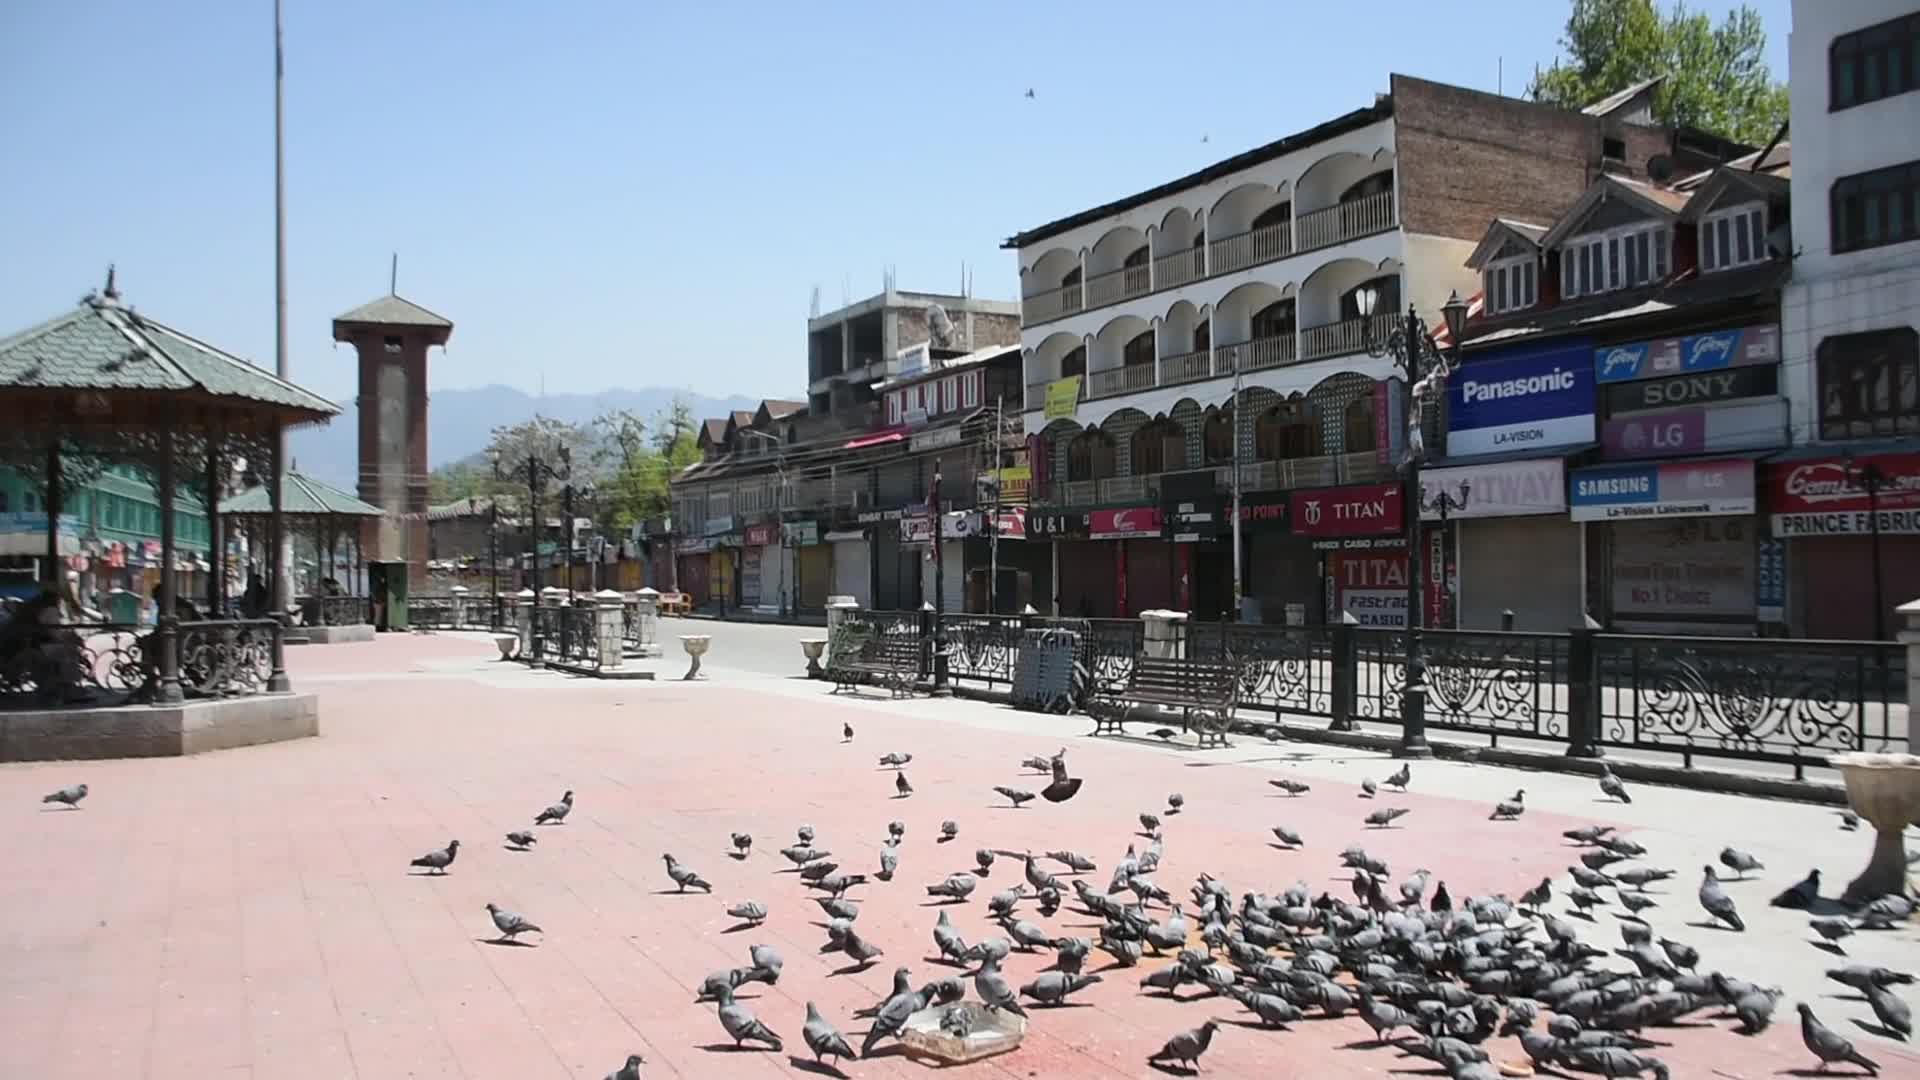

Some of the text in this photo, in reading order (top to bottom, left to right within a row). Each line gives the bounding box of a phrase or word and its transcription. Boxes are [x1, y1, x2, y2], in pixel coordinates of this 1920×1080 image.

[1463, 367, 1574, 403] Panasonic
[1643, 374, 1737, 405] SONY
[1493, 429, 1544, 445] LA-VISION
[1653, 422, 1685, 447] LG
[1578, 476, 1650, 497] SAMSUNG
[1253, 504, 1286, 521] POINT
[1332, 501, 1385, 520] TITAN
[1032, 517, 1042, 533] U
[1047, 515, 1056, 532] &
[1782, 513, 1849, 534] PRINCE
[1344, 539, 1371, 549] CASIO
[1343, 559, 1409, 586] TITA
[1360, 613, 1404, 626] CASIO
